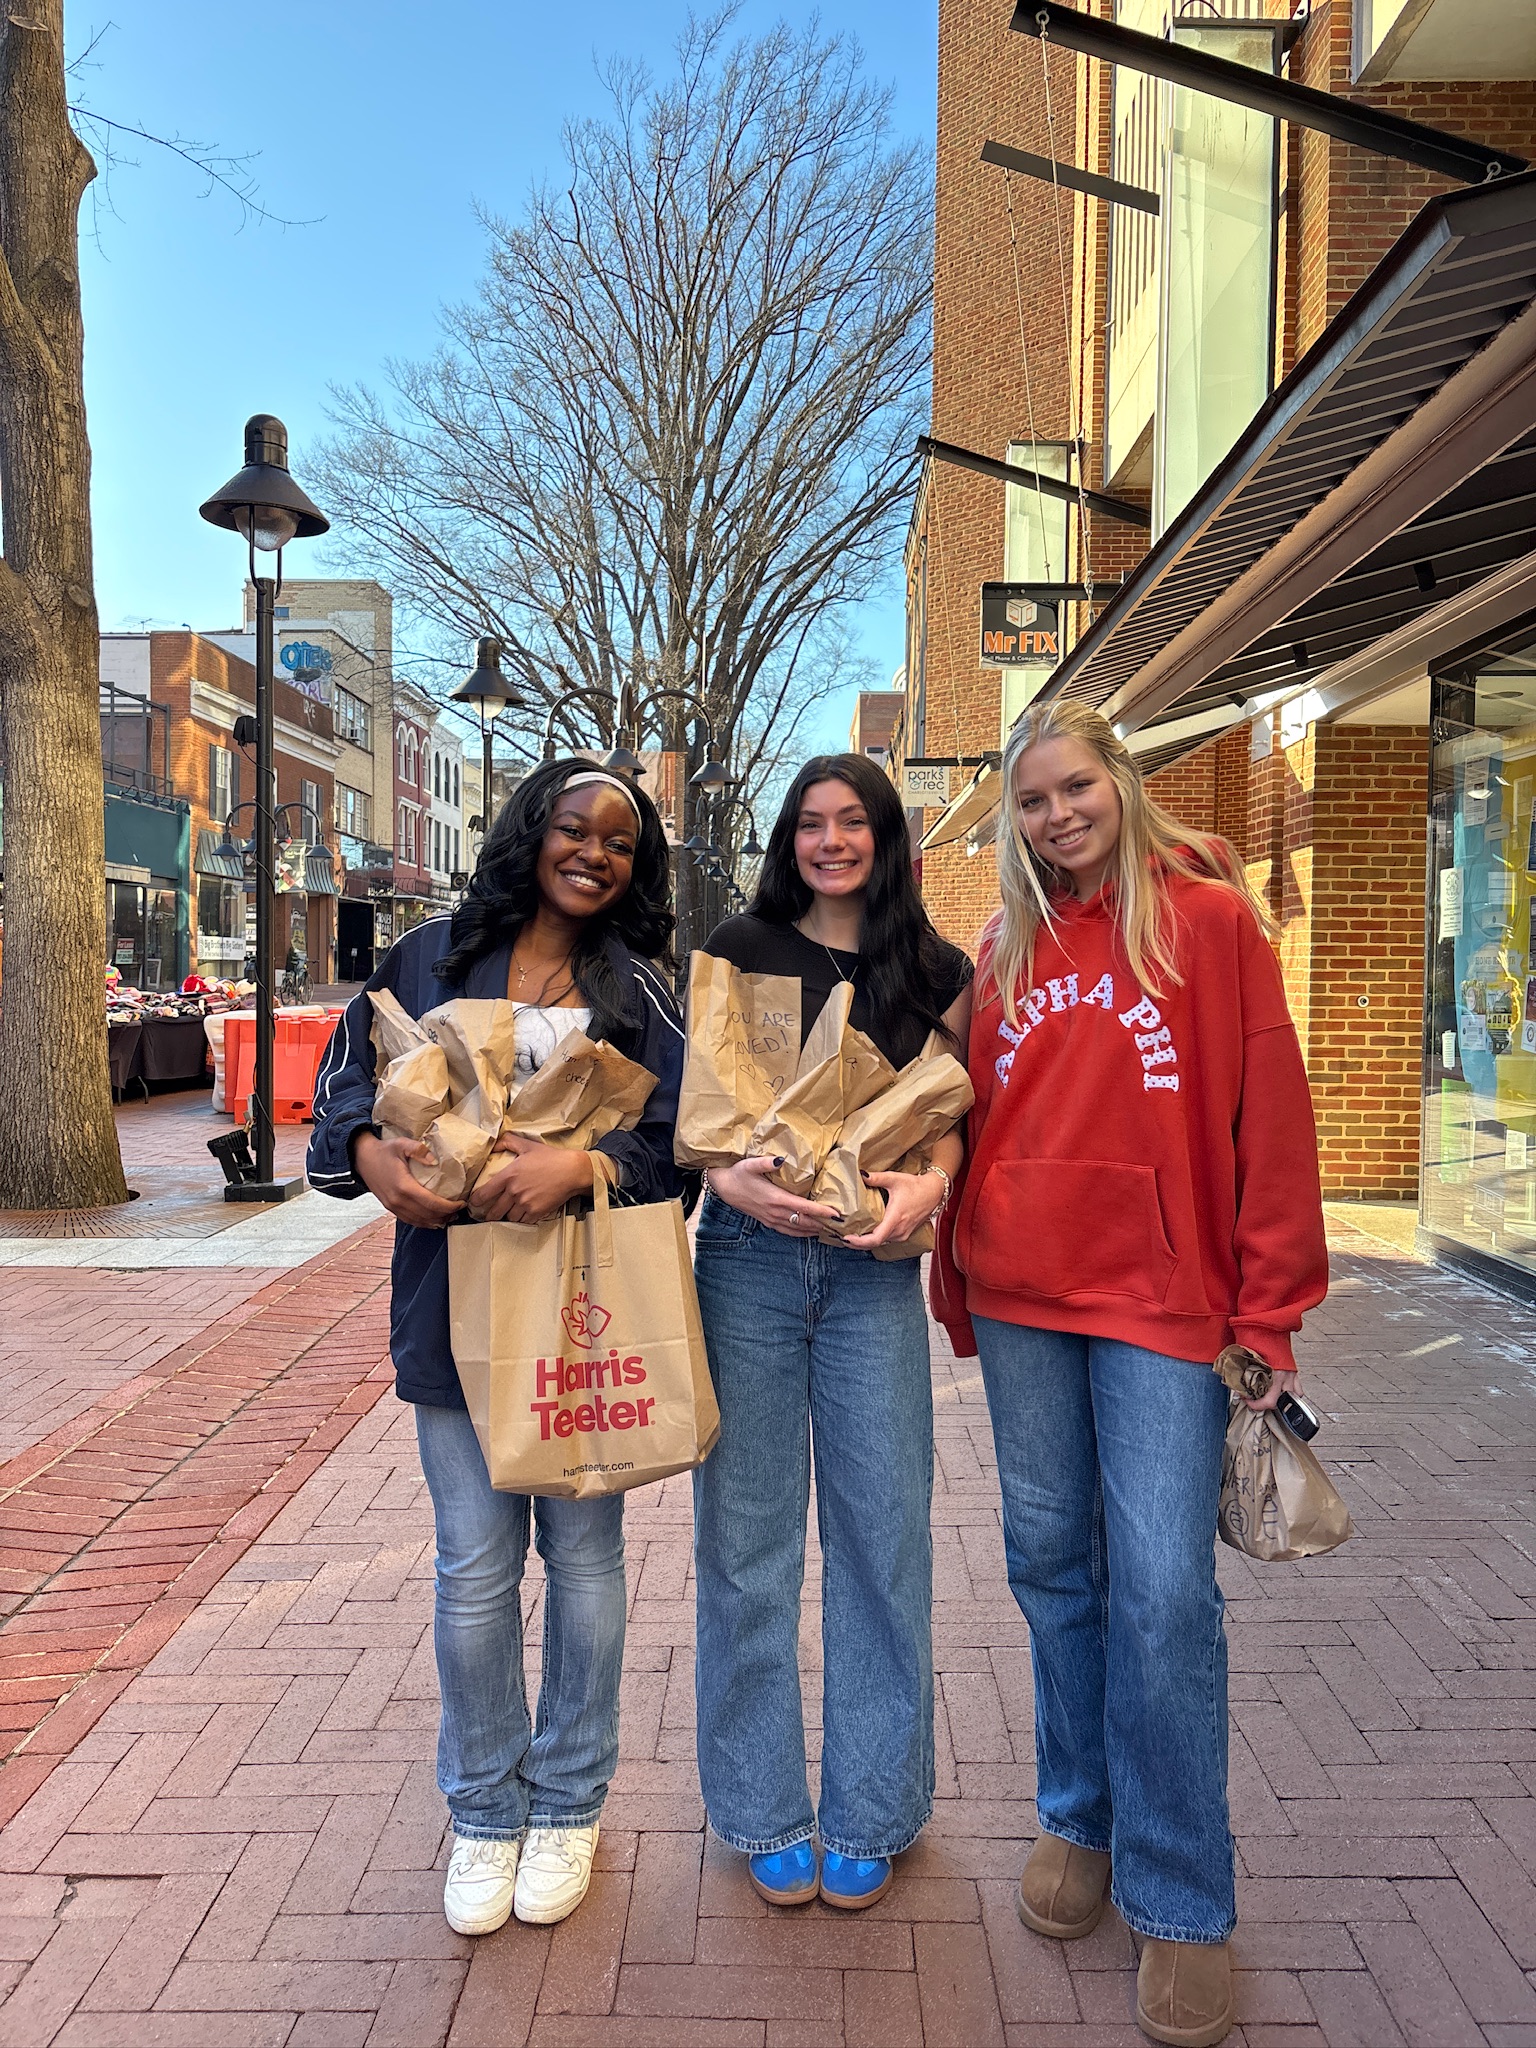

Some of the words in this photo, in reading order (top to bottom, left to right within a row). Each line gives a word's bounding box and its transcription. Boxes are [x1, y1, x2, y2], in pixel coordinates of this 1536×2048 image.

[984, 630, 1017, 654] Mr
[1019, 630, 1058, 654] FIX
[908, 769, 944, 782] parks
[923, 780, 945, 790] rec
[762, 1012, 795, 1028] ARE
[994, 972, 1114, 1089] ALPHA
[1118, 995, 1180, 1093] PHI
[535, 1349, 647, 1398] Harris
[530, 1394, 656, 1441] Teeter
